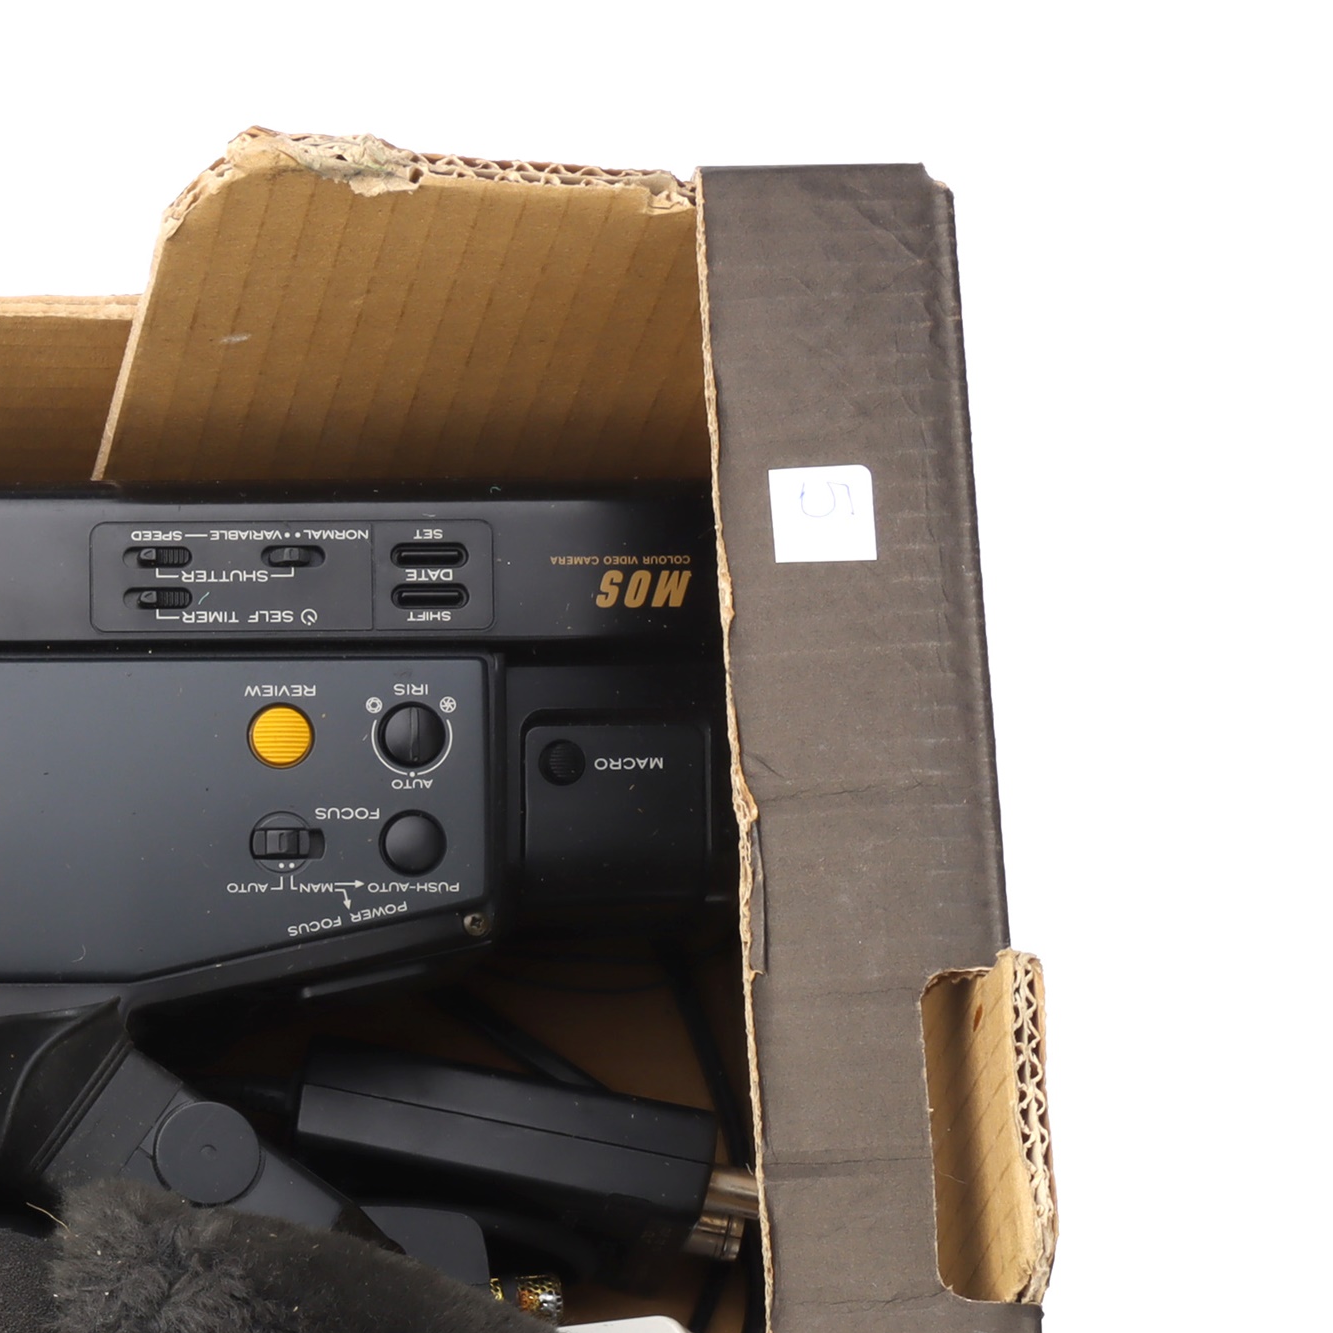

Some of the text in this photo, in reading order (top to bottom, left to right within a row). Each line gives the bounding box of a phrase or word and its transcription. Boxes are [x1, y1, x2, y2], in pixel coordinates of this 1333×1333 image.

[130, 529, 369, 542] NORMAL VARIABLE SPEED
[413, 528, 443, 540] SET
[550, 555, 691, 566] COLOUR VIDEO CAMERA
[181, 569, 269, 583] SHUTTER
[406, 568, 453, 581] DATE
[595, 569, 692, 609] MOS
[182, 610, 295, 623] SELF TIMER
[407, 610, 452, 622] SHIFT
[243, 684, 317, 697] REVIEW
[393, 683, 430, 696] IRIS
[594, 756, 664, 770] MACRO
[391, 777, 434, 790] AUTO
[314, 806, 380, 820] FOCUS
[226, 881, 267, 893] AUTO
[299, 881, 334, 893] MAN
[367, 881, 460, 893] PUSH-AUTO
[287, 900, 408, 937] POWER FOCUS
